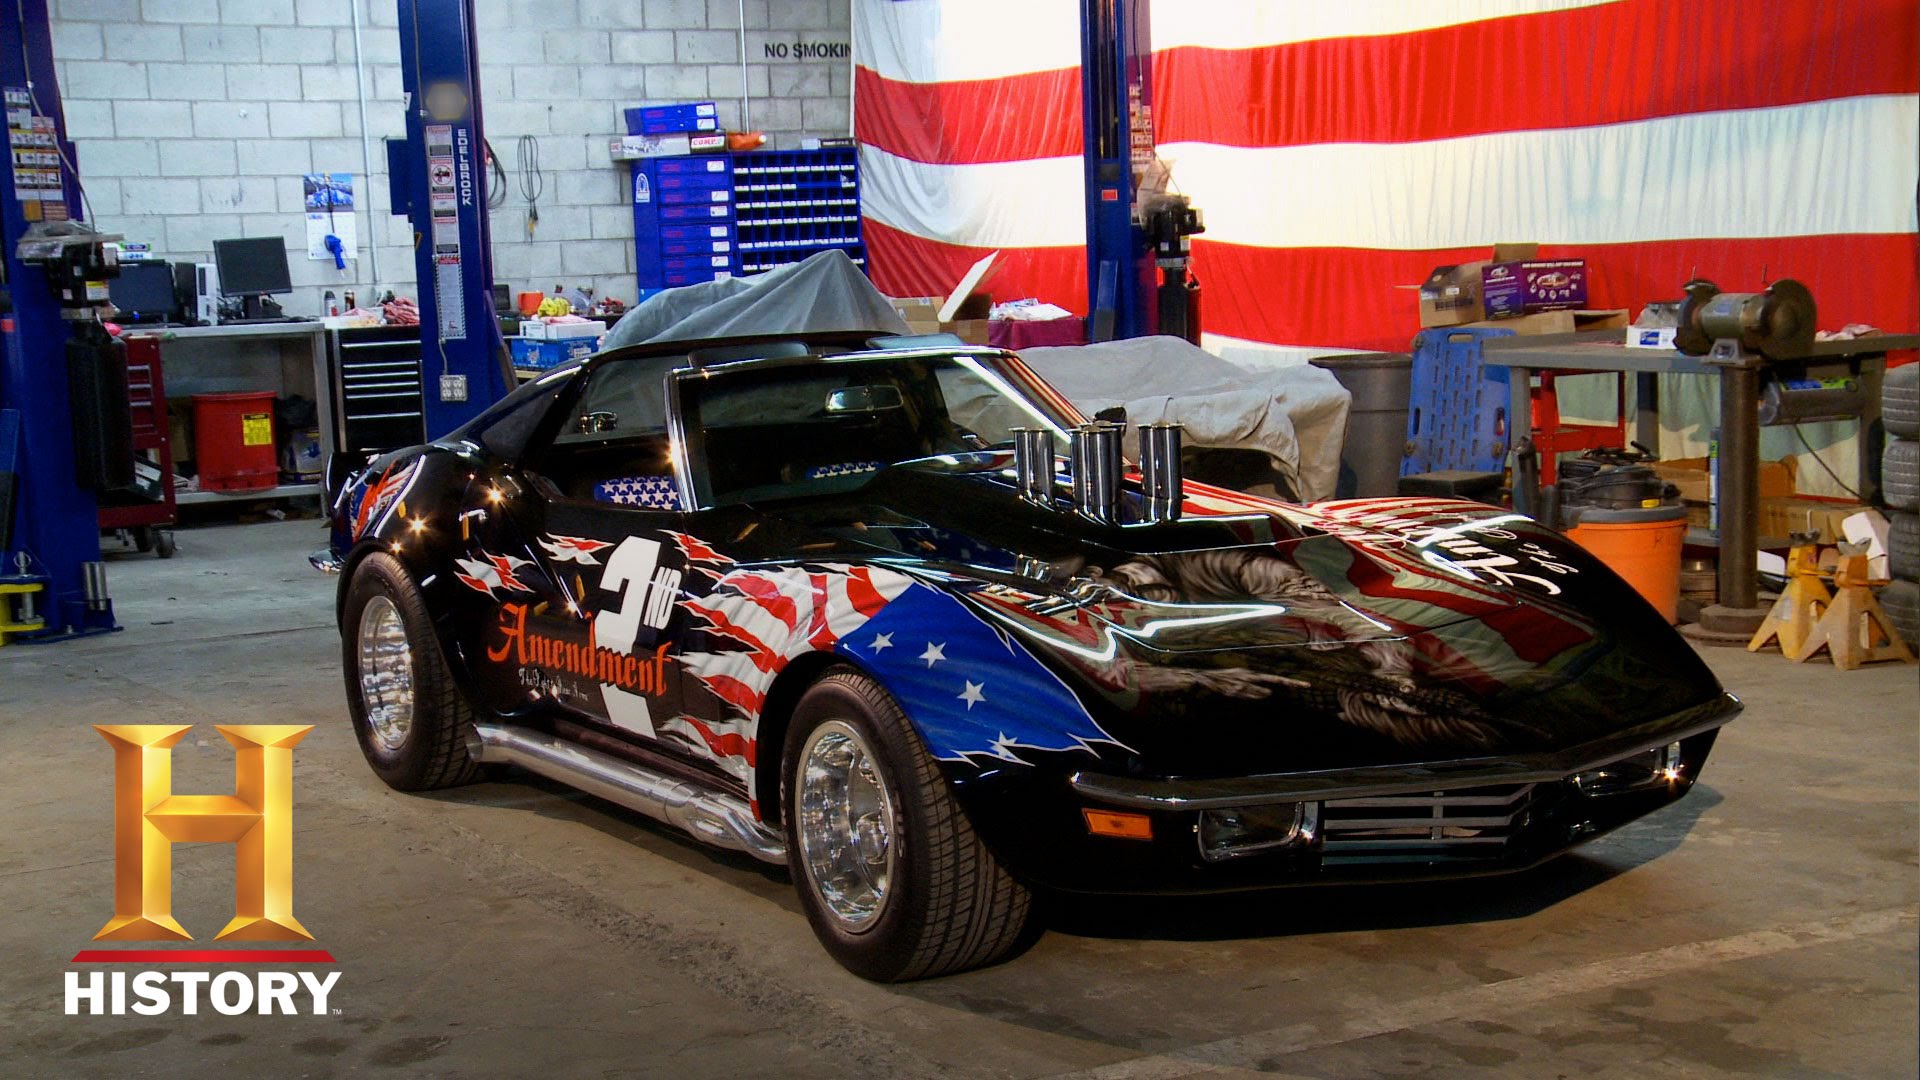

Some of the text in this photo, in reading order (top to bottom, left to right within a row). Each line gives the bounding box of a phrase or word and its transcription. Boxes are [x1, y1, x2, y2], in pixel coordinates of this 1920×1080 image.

[764, 43, 788, 58] NO
[457, 128, 472, 206] EDELBROCK
[487, 602, 672, 697] Amendment
